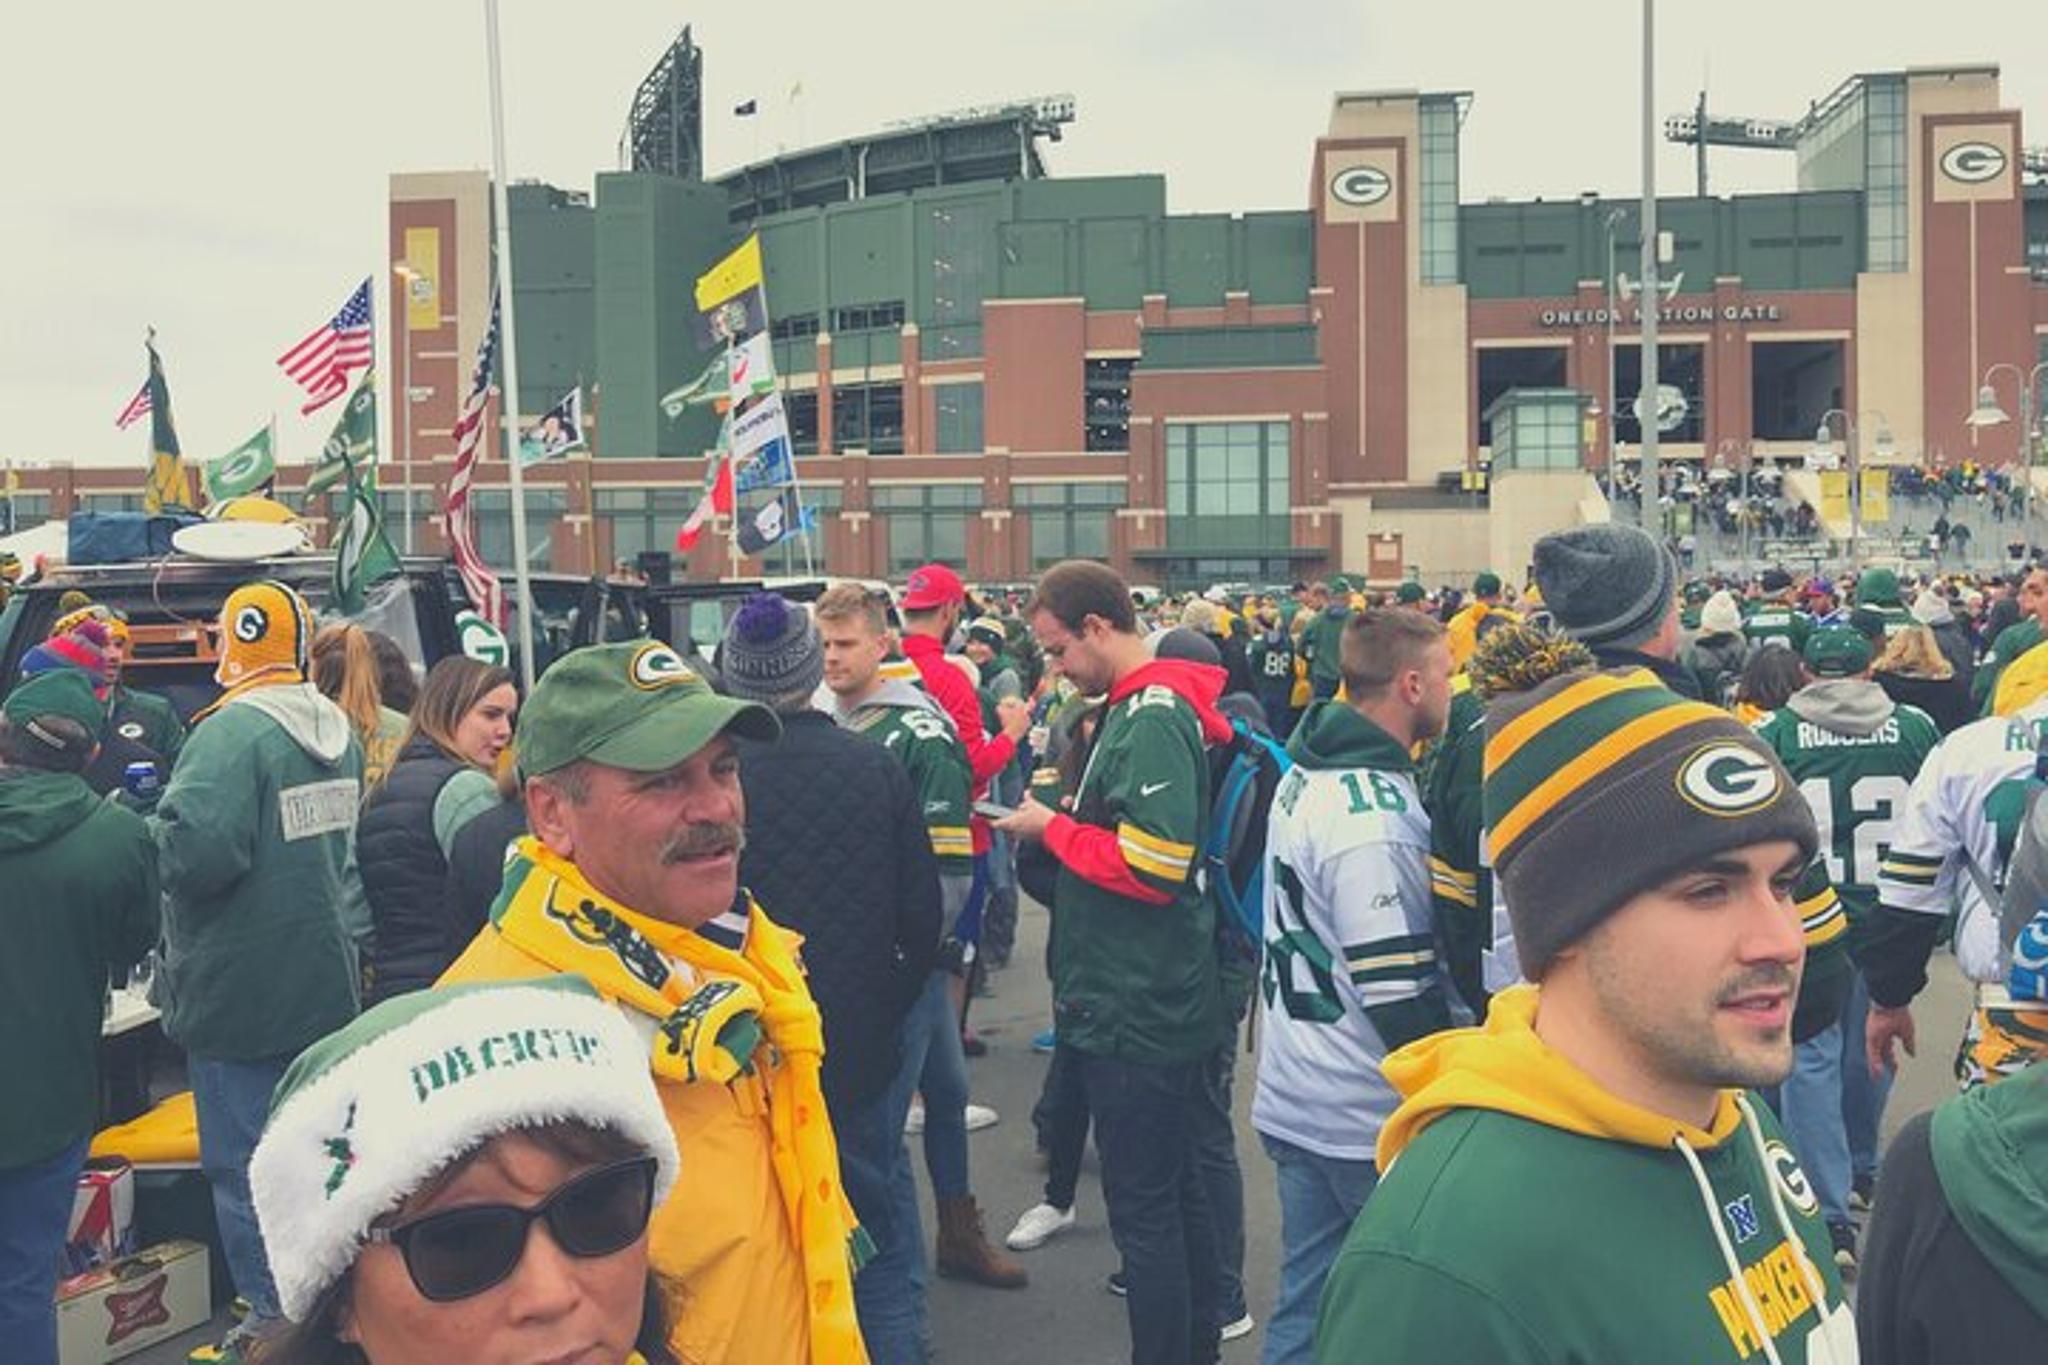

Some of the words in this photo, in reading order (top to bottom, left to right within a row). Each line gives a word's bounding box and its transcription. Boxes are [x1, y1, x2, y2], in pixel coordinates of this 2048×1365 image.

[1542, 306, 1622, 326] ONEIDA
[1723, 305, 1780, 321] GATE
[1797, 717, 1900, 749] RORS
[1679, 741, 1780, 812] G
[1799, 776, 1910, 886] 12
